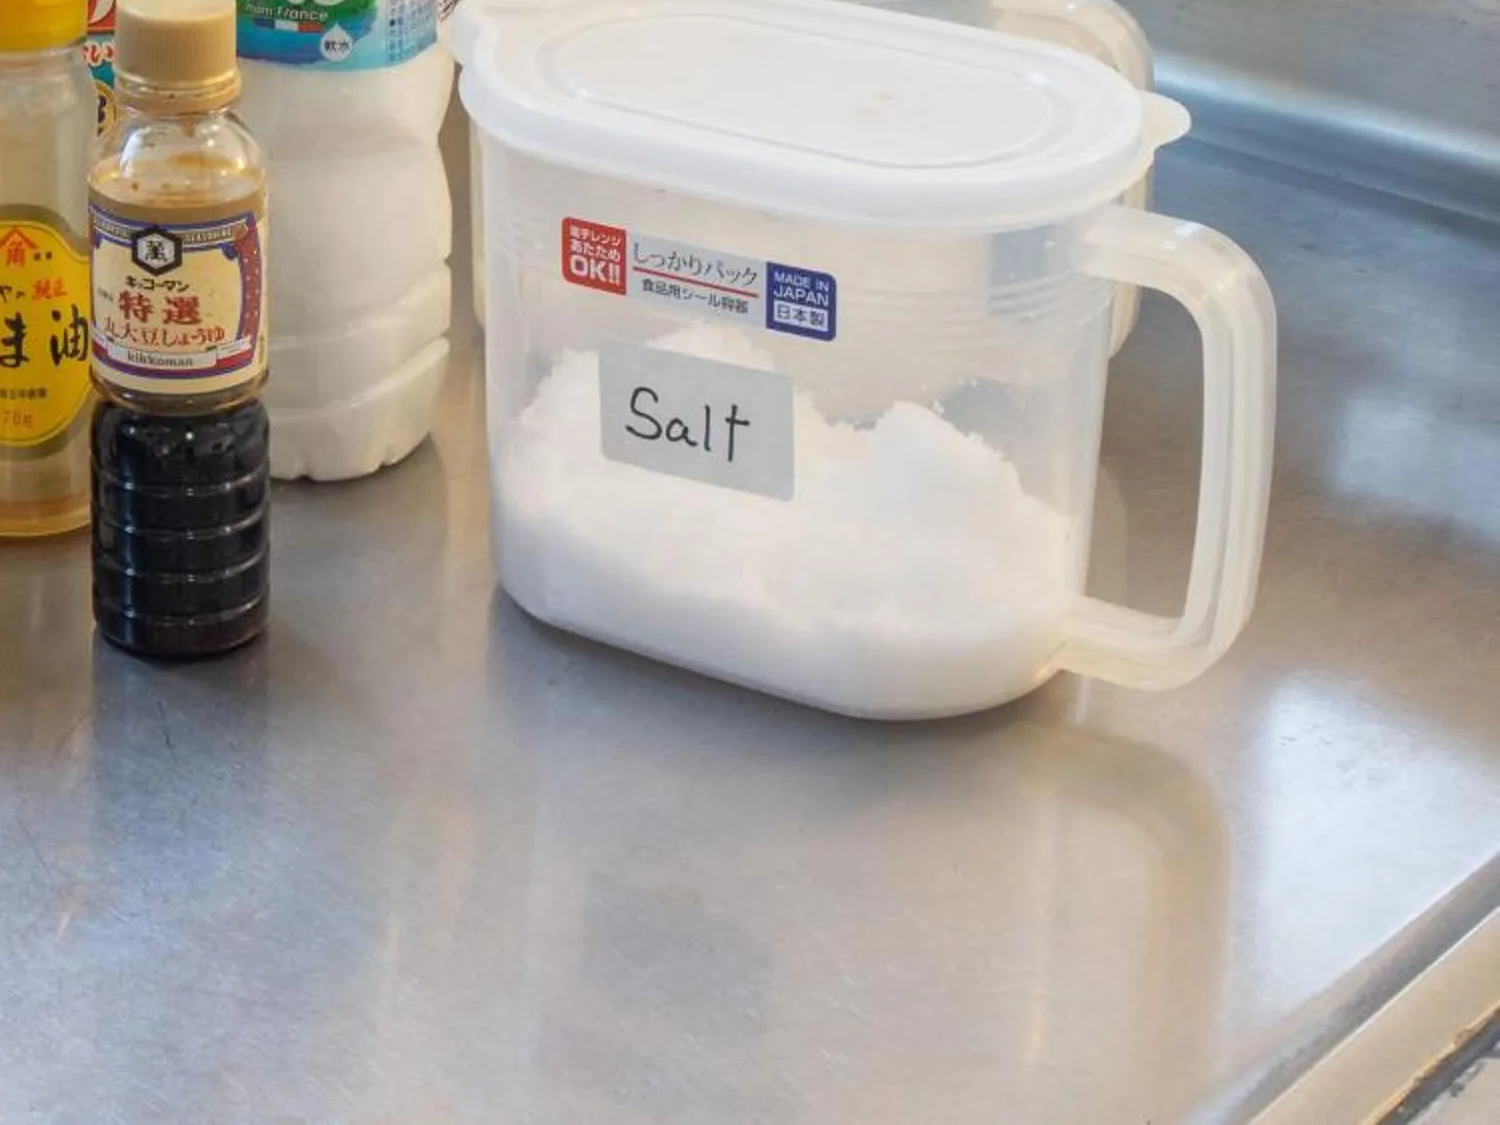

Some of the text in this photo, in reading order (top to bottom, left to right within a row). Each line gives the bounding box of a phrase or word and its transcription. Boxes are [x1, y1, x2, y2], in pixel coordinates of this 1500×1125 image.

[277, 6, 328, 21] France
[571, 239, 621, 262] あたため
[634, 241, 758, 286] しっかりパック
[126, 275, 190, 293] キッコーマン
[773, 271, 830, 292] MADE IN
[118, 290, 201, 325] 特選
[772, 286, 830, 307] JAPAN
[776, 303, 826, 327] 日本製
[104, 316, 226, 348] 丸大豆しょうゆ
[127, 349, 193, 367] kikkoman
[624, 385, 751, 463] Salt
